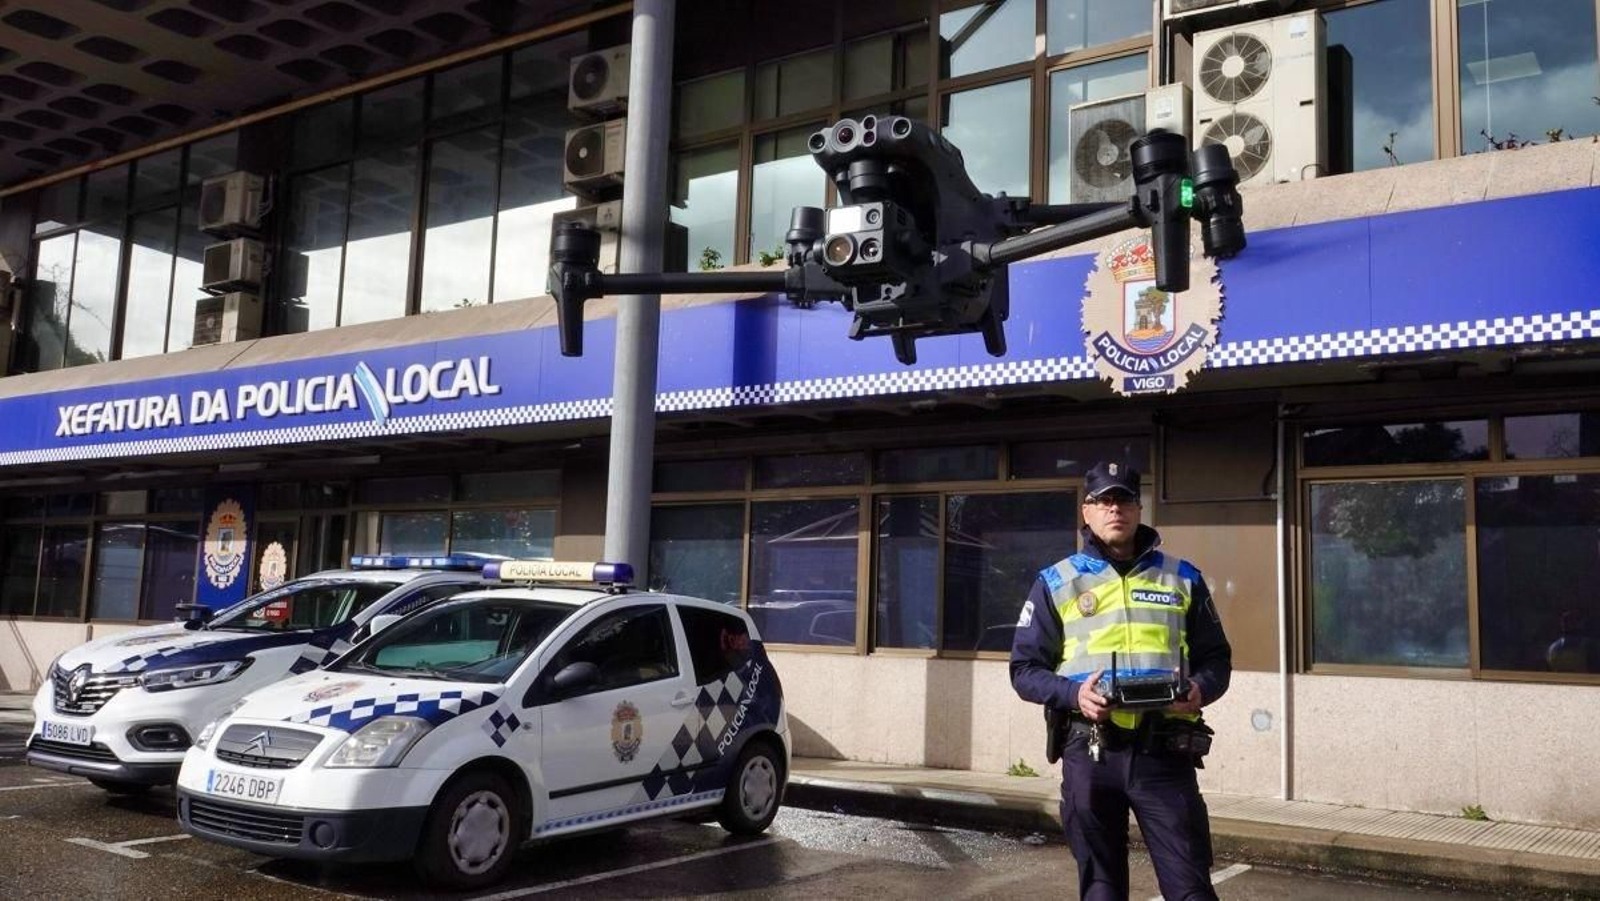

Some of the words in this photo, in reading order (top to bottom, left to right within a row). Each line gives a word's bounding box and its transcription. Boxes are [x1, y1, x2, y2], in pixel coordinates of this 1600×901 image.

[1098, 336, 1150, 371] POLICIA
[1160, 329, 1203, 367] LOCAL
[1132, 377, 1165, 389] VIGO
[55, 393, 182, 437] XEFATURA
[189, 388, 231, 425] DA
[236, 373, 358, 420] POLICIA
[385, 356, 500, 405] LOCAL
[510, 564, 547, 577] POLICIA
[550, 566, 582, 577] LOCAL
[1132, 592, 1170, 603] PILOTO
[717, 703, 749, 756] POLICIA
[745, 662, 763, 699] LOCAL
[47, 723, 69, 740] 5086
[70, 725, 88, 743] LVD
[214, 773, 246, 795] 2246
[248, 778, 276, 799] DBP
